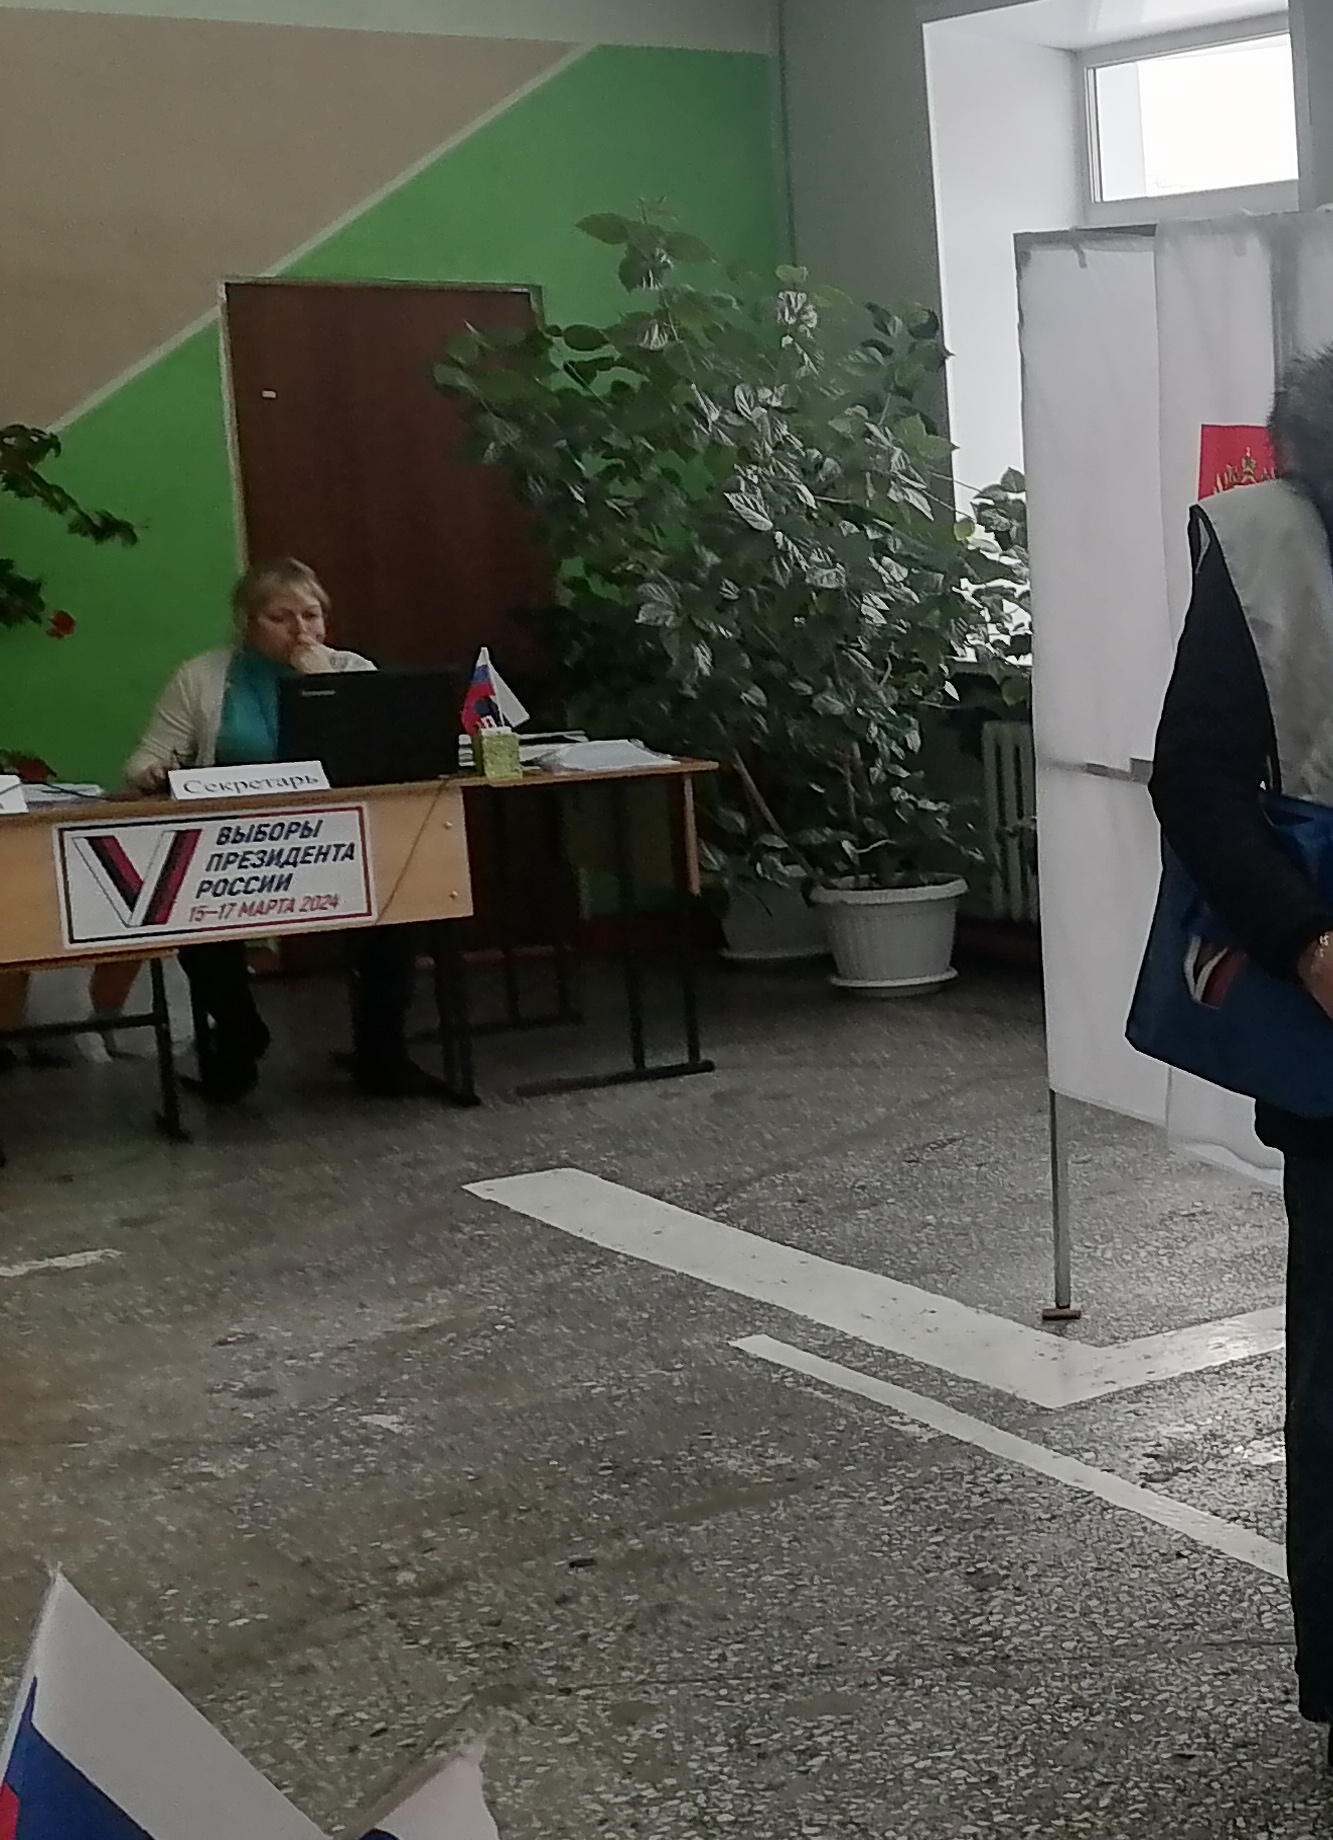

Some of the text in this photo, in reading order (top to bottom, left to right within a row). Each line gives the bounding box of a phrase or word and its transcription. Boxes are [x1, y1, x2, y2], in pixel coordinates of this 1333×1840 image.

[183, 775, 319, 794] Секретарь
[215, 819, 324, 846] ВЫБОРЫ
[205, 842, 356, 872] ПРЕЗИДЕНТА
[71, 829, 202, 927] V
[195, 873, 294, 899] РОССИИ
[238, 897, 296, 918] МАРТА
[298, 893, 340, 913] 2024
